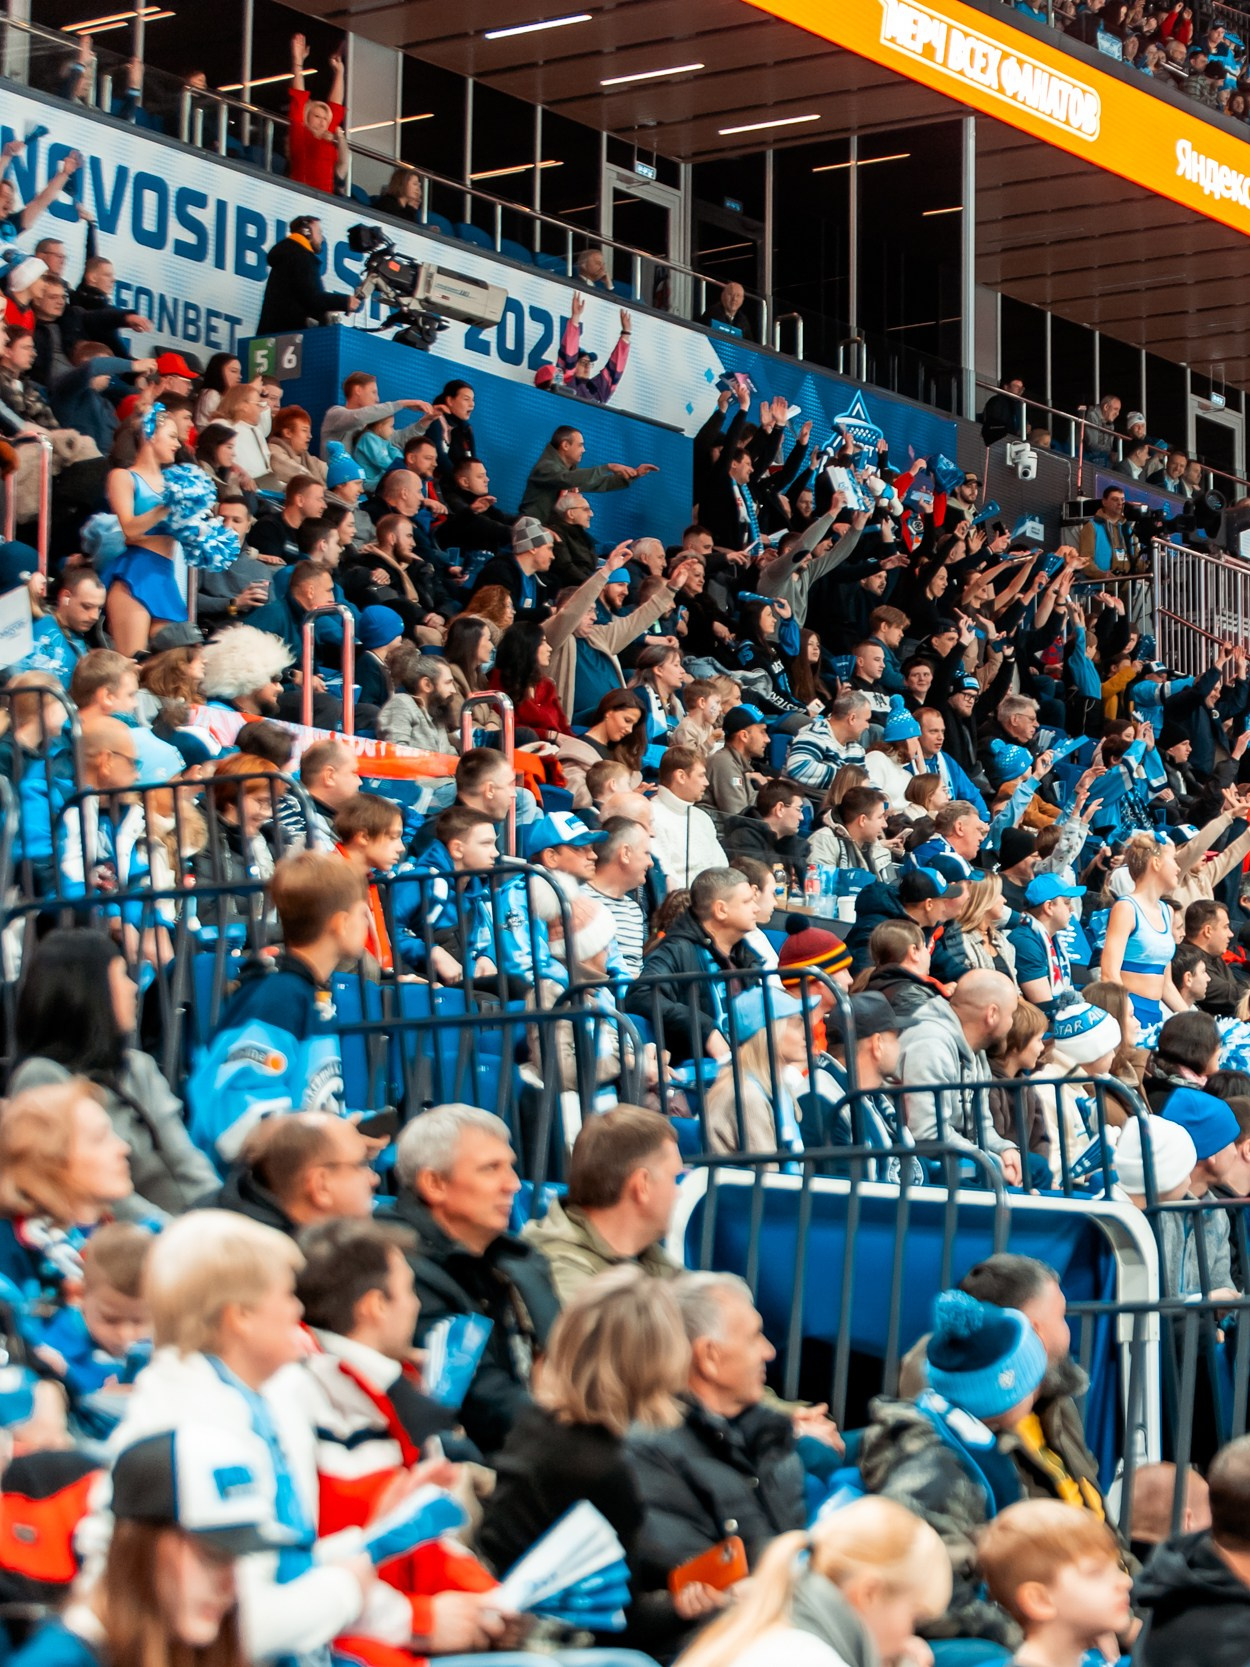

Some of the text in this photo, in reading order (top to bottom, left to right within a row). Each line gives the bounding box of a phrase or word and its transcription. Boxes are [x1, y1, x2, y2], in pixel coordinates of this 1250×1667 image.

[948, 28, 1002, 90] ВСЕХ
[1000, 56, 1099, 135] ФАНАТОВ
[254, 345, 298, 374] 5 6
